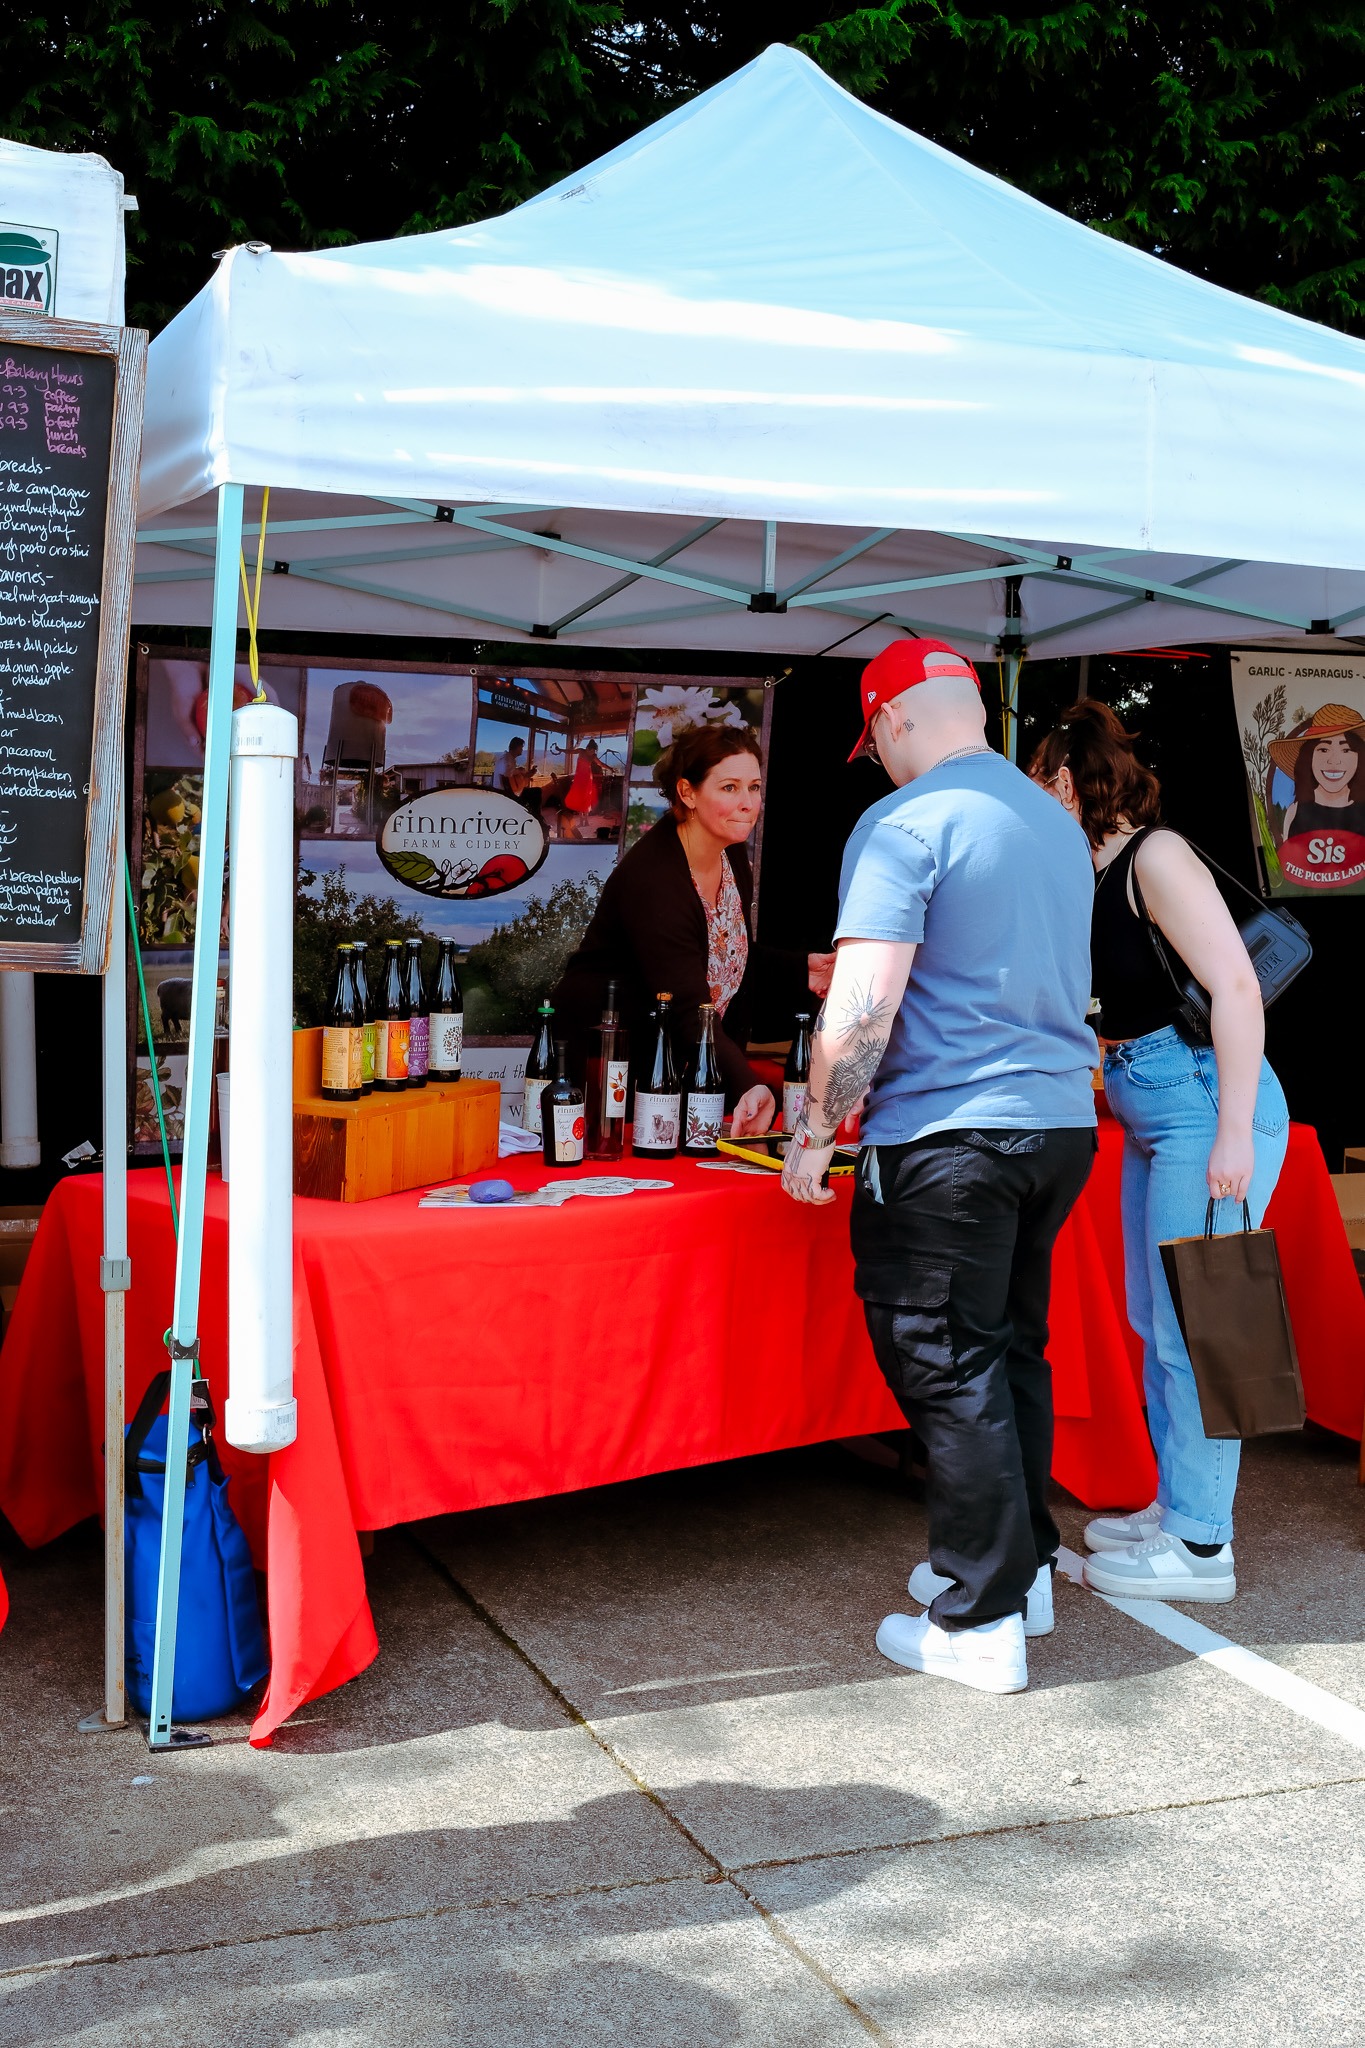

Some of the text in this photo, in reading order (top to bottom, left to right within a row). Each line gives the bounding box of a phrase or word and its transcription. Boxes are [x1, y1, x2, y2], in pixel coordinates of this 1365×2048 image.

[4, 358, 84, 392] Bakery Hours
[44, 389, 79, 405] coffee
[45, 402, 80, 421] pastry
[46, 427, 79, 443] lunch
[47, 439, 87, 458] breads
[48, 519, 76, 542] loaf
[20, 542, 46, 562] pesto
[23, 637, 42, 651] dill
[43, 637, 78, 658] pickle
[1248, 666, 1285, 677] GARLIC
[1294, 667, 1354, 679] ASPARAGUS
[402, 838, 521, 850] FARM & CIDERY
[1306, 837, 1346, 864] Sis
[1285, 861, 1304, 879] THE
[1304, 870, 1340, 882] PICKLE
[487, 1065, 507, 1079] and
